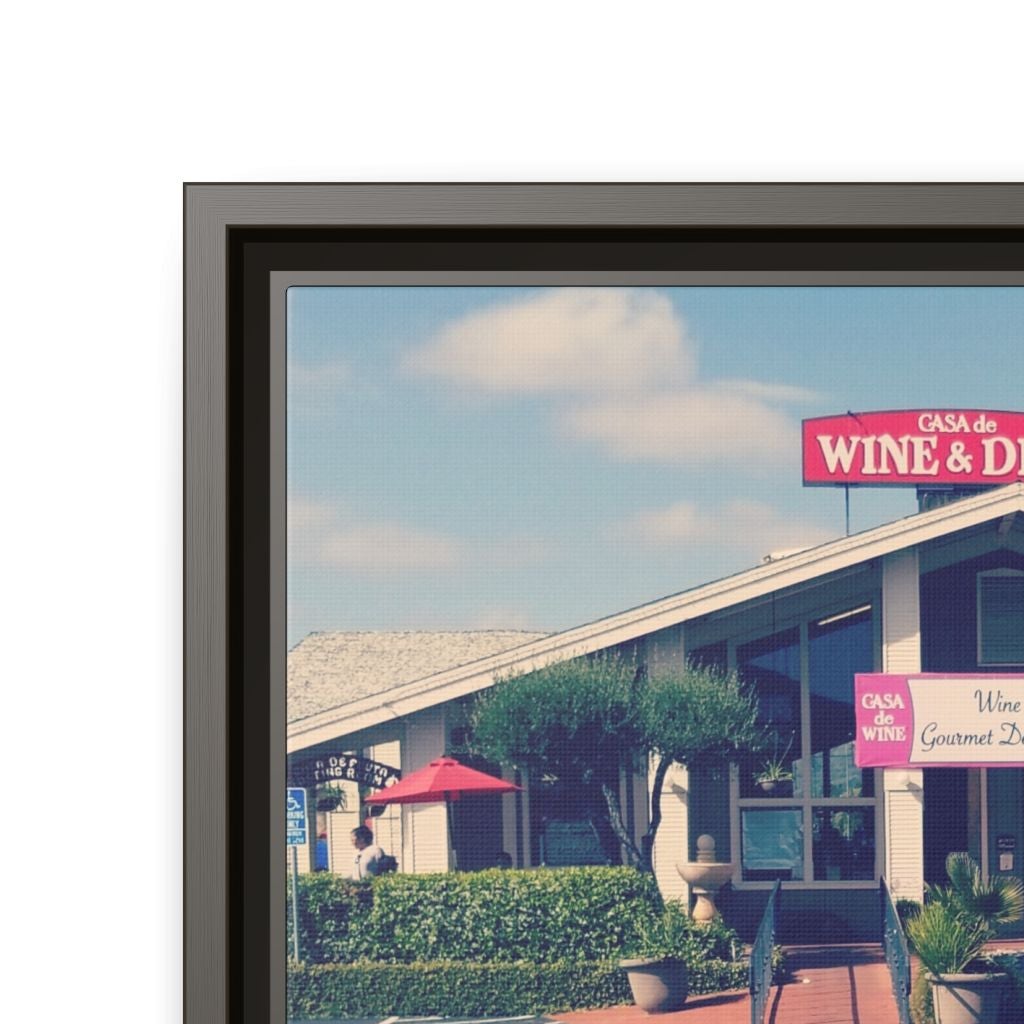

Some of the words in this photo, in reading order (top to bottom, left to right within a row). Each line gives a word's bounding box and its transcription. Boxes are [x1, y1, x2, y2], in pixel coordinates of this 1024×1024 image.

[918, 414, 970, 433] CASA
[973, 413, 997, 433] de
[817, 434, 939, 475] WINE
[946, 441, 973, 473] &
[861, 693, 905, 709] CASA
[974, 689, 1021, 714] Wine
[874, 711, 894, 725] de
[862, 726, 906, 742] WINE
[921, 722, 993, 752] Gourmet
